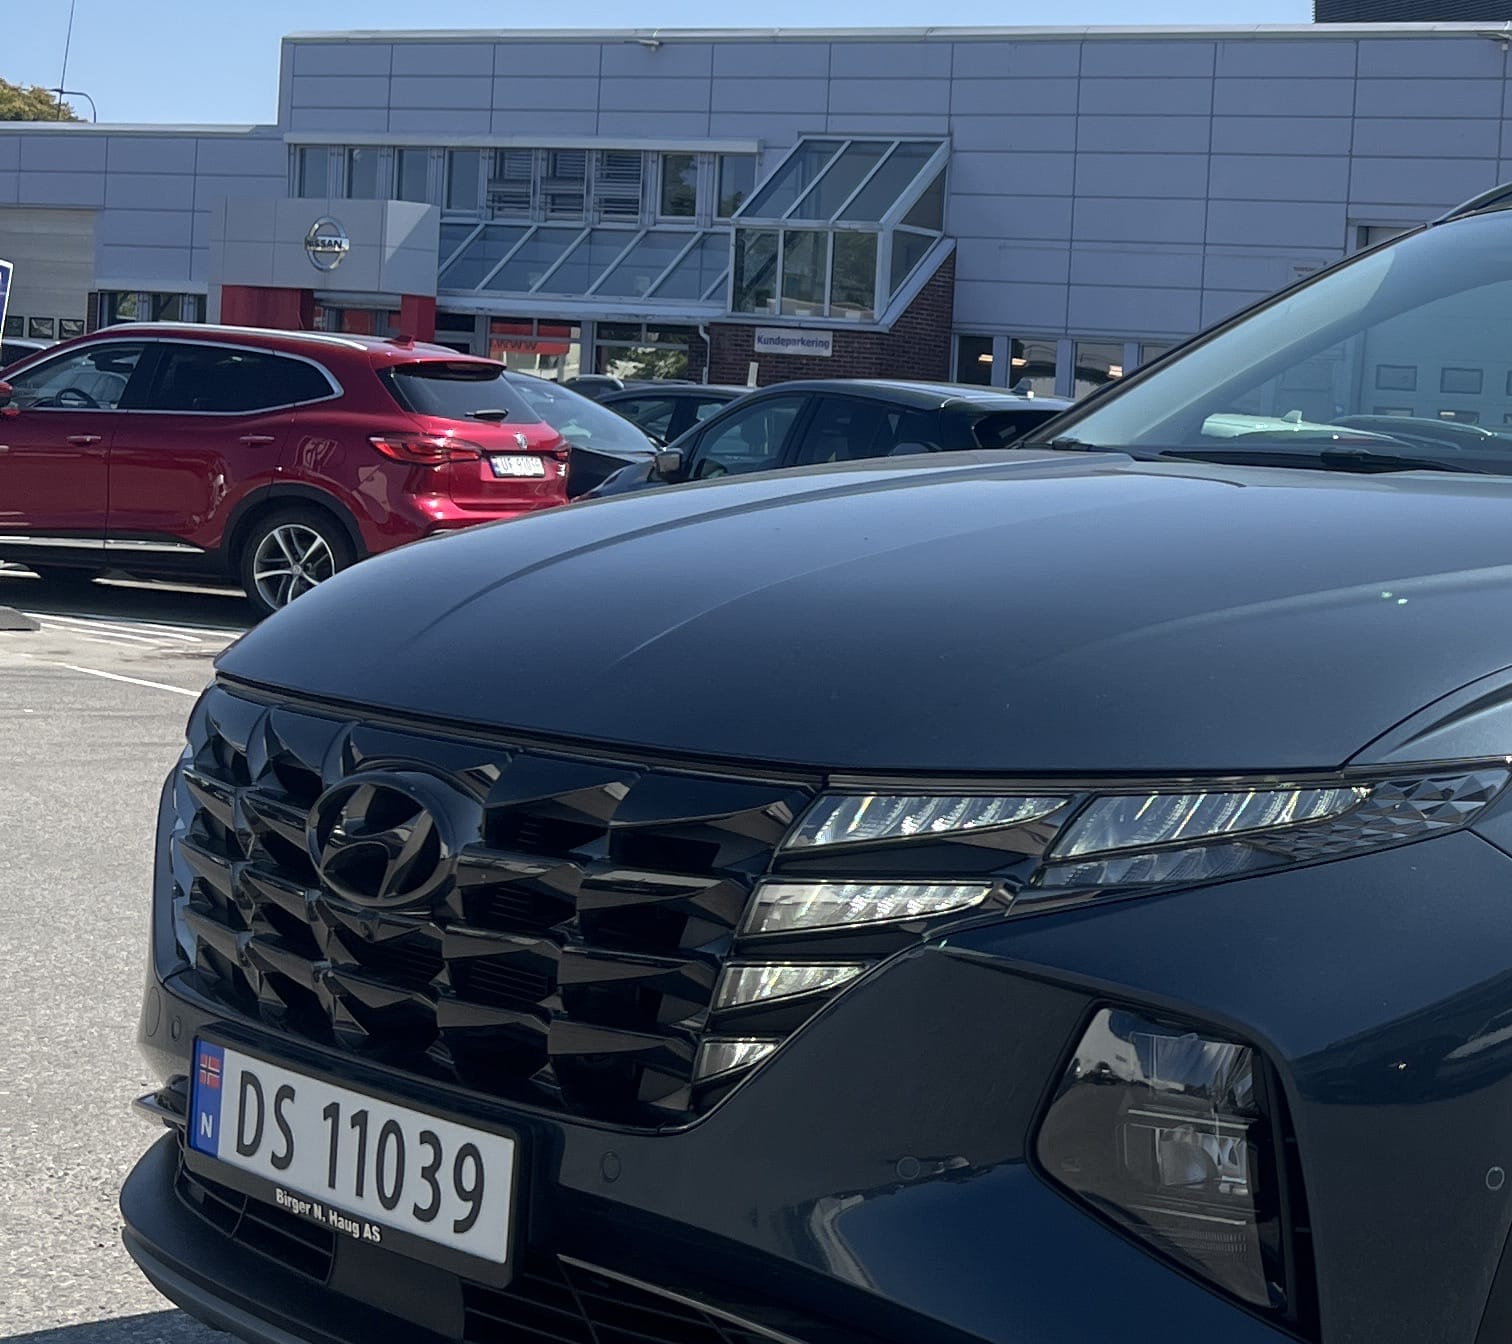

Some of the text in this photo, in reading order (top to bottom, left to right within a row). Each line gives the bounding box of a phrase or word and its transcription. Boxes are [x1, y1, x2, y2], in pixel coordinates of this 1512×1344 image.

[757, 335, 831, 350] Kundeparkering
[199, 1111, 213, 1138] N
[236, 1070, 485, 1234] DS 11039
[275, 1188, 381, 1243] Birger N. Haug AS
